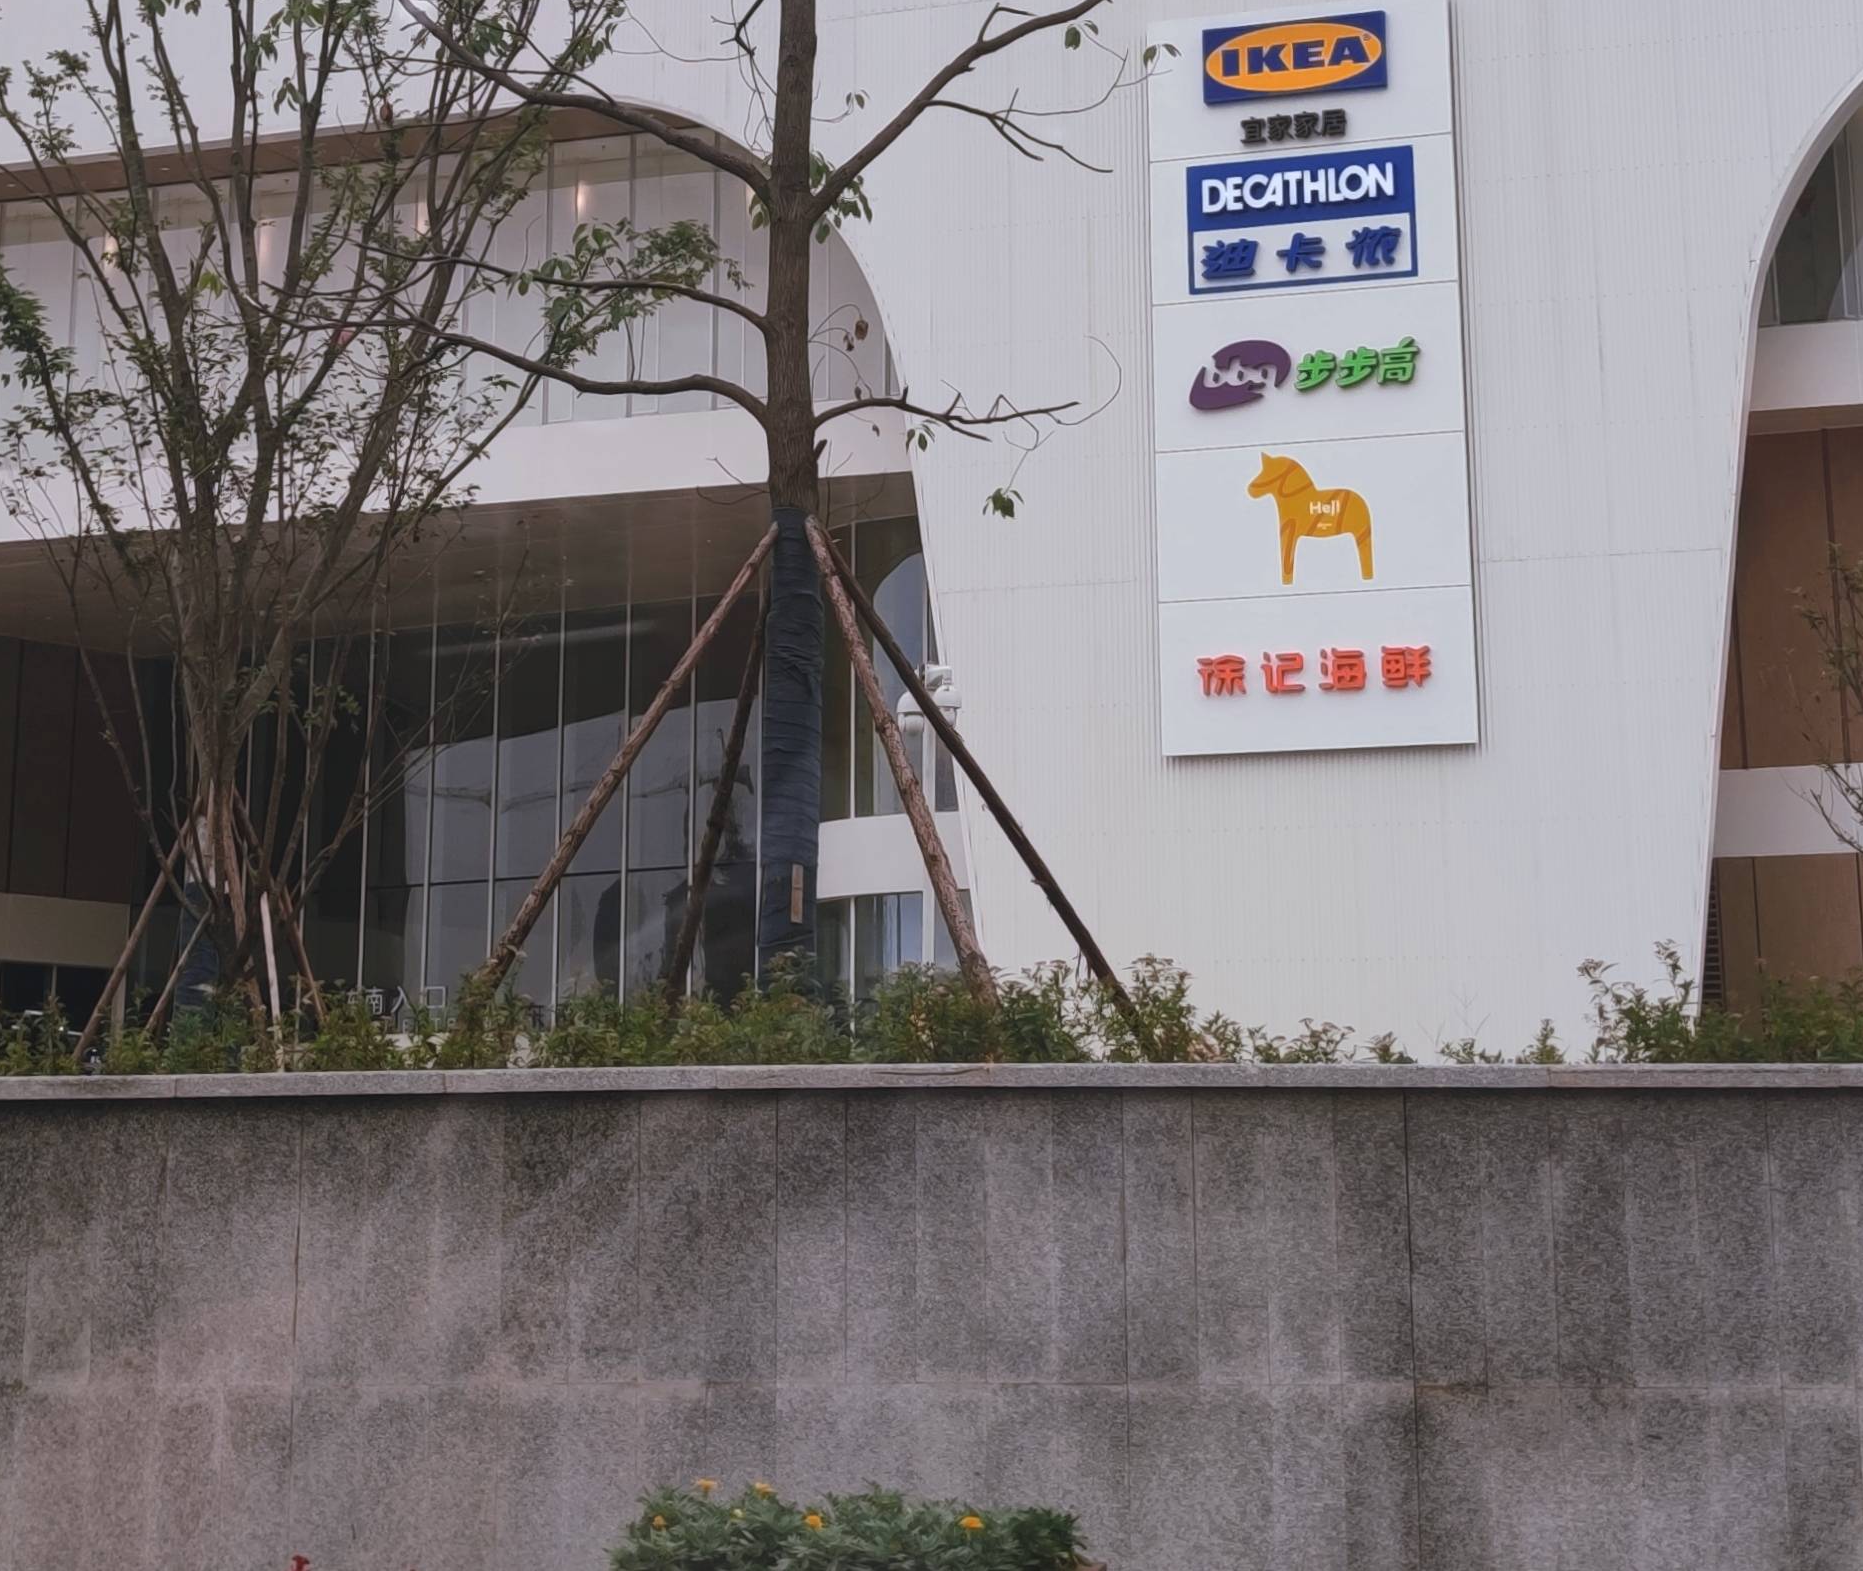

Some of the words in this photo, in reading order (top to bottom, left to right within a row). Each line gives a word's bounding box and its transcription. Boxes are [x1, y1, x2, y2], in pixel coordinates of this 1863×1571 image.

[1221, 34, 1371, 78] IKEA
[1239, 108, 1348, 145] 宜家家居
[1200, 161, 1395, 215] DECATHLON
[1200, 224, 1402, 283] 迪卡侬
[1294, 336, 1421, 392] 步步高
[1196, 644, 1432, 698] 徐记海鲜
